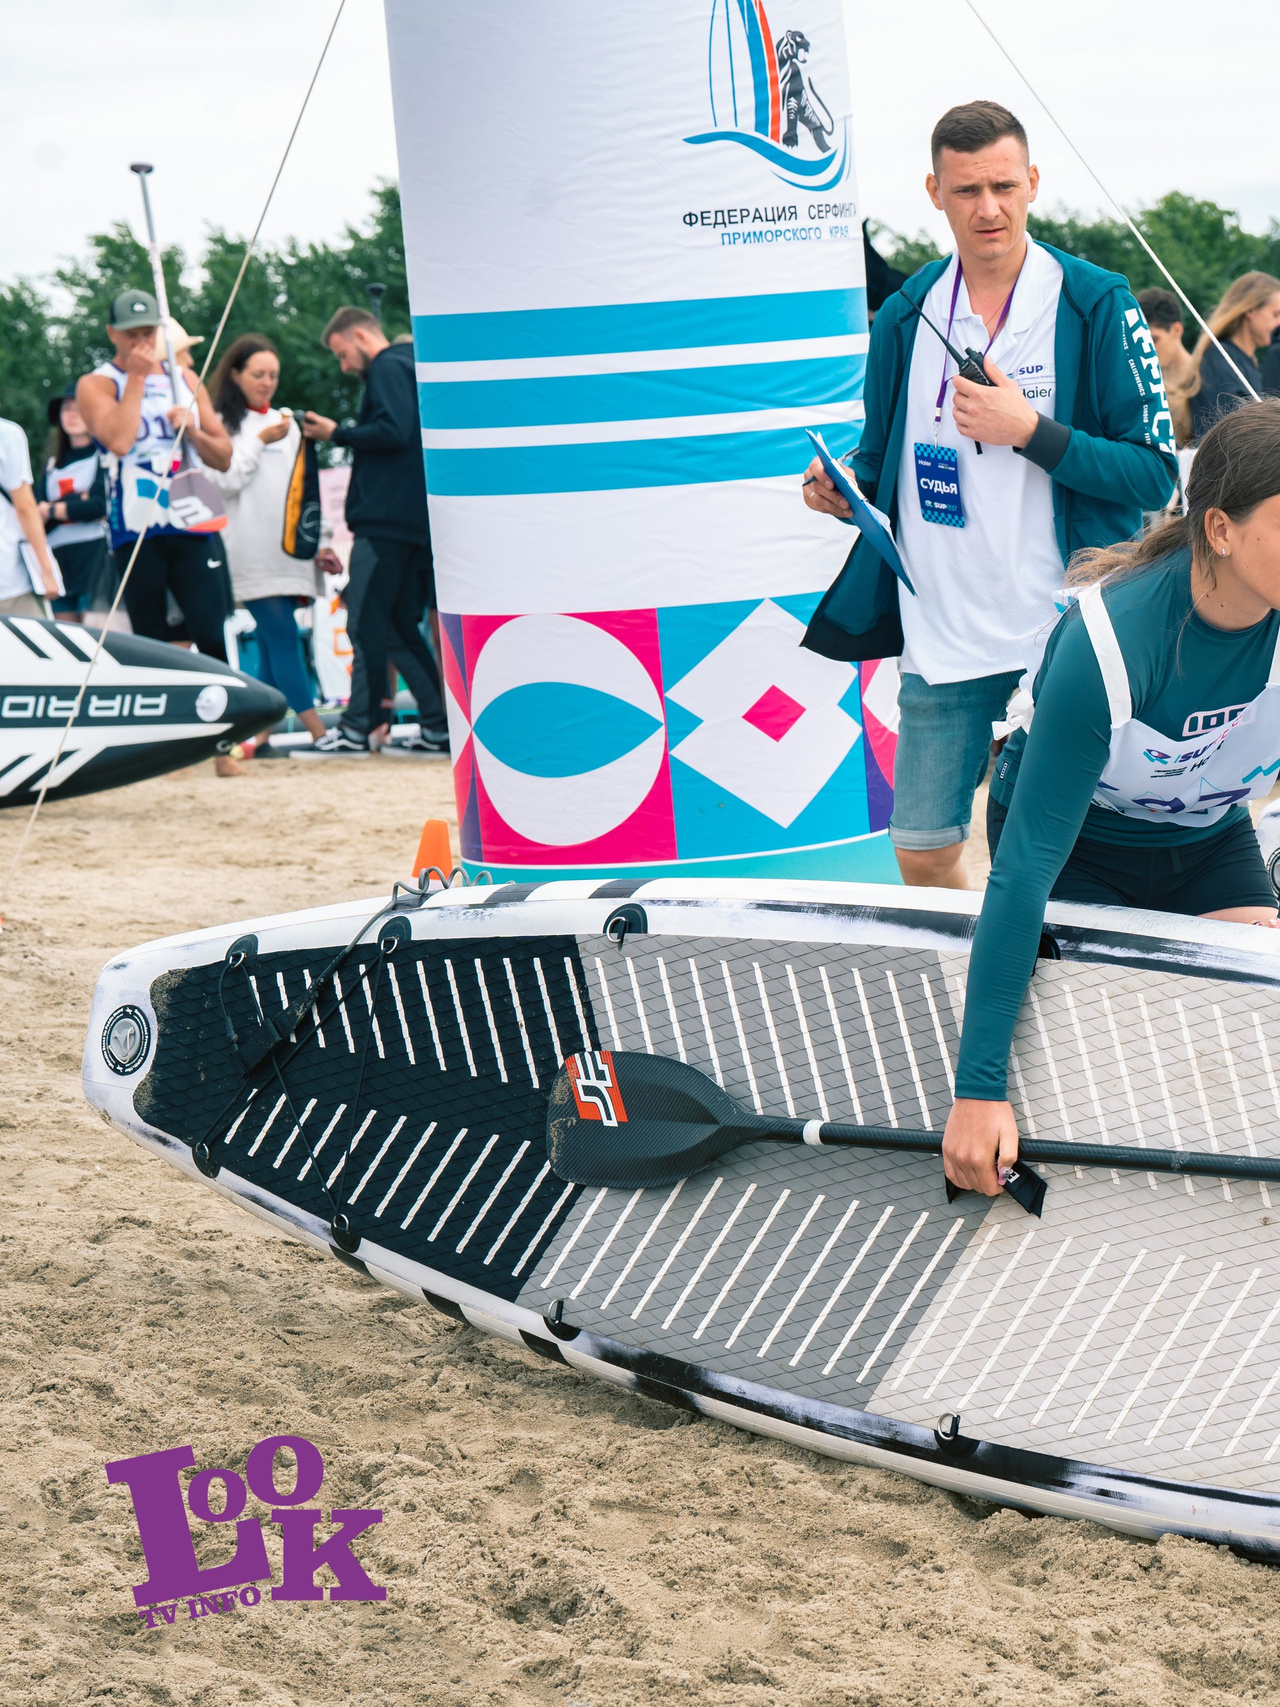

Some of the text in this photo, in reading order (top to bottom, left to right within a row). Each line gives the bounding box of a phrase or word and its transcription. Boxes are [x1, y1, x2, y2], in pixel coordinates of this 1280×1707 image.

[682, 202, 857, 229] ФЕДЕРАЦИЯ СЕРФИНГА
[721, 225, 849, 246] ПРИМОРСКОГО КРАЯ
[920, 477, 958, 495] СУДЬЯ
[0, 694, 82, 718] RID
